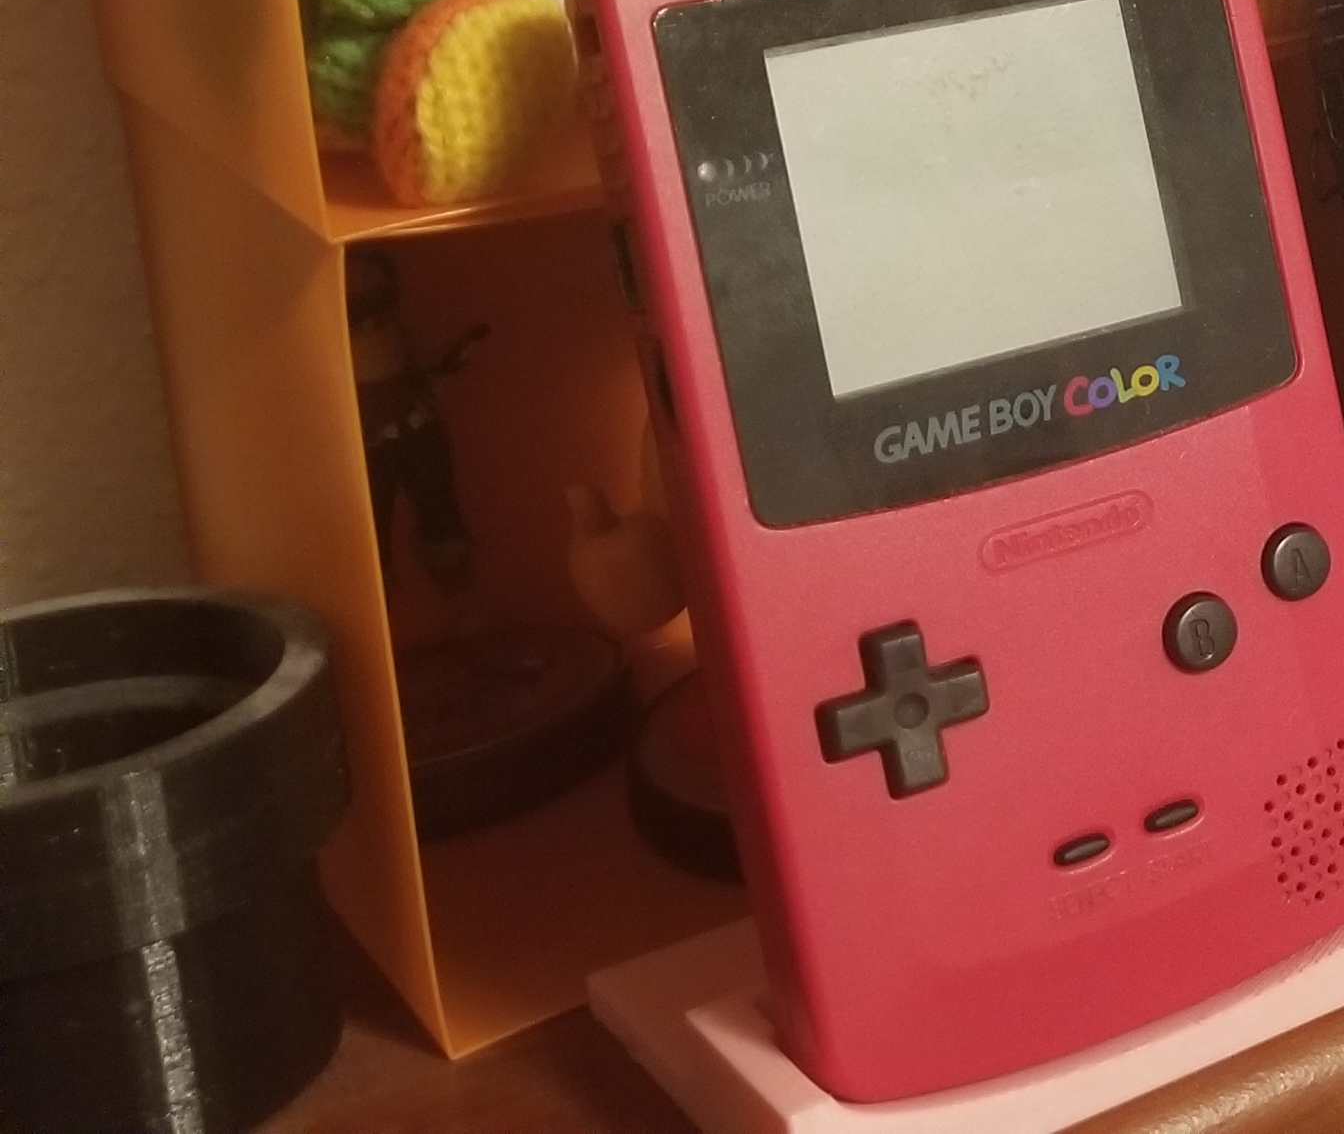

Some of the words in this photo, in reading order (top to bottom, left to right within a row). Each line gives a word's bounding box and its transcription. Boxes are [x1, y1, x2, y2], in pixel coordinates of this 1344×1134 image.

[703, 180, 773, 208] POWER
[872, 405, 982, 465] GAME
[988, 383, 1058, 438] BOY
[1062, 353, 1187, 417] COLOR
[992, 496, 1144, 562] Nintendo
[1287, 547, 1313, 591] A
[1188, 617, 1217, 663] B
